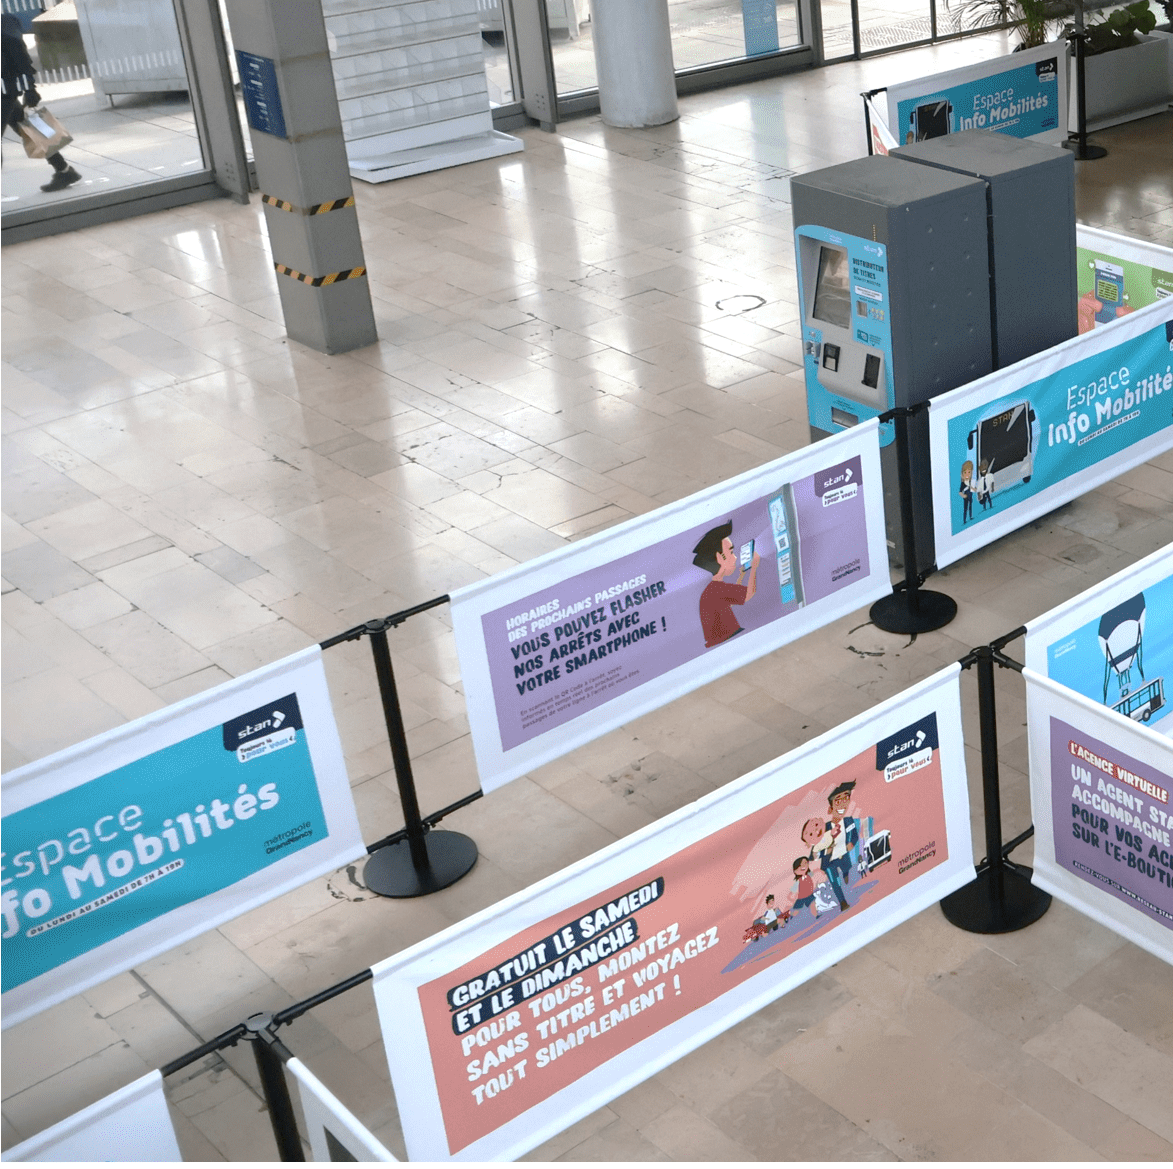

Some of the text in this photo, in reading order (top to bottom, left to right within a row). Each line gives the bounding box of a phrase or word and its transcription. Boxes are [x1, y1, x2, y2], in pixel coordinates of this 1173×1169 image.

[960, 92, 1048, 131] Info Mobilités
[973, 87, 1014, 111] Espace
[1066, 366, 1131, 411] Espace
[1048, 410, 1090, 447] Info
[823, 474, 844, 488] stan
[506, 598, 560, 631] HORAIRES
[507, 574, 647, 643] DES PROCHAINS PASSAGES
[511, 580, 666, 660] VOUS POUVEZ FLASHER
[514, 611, 640, 679] NOS ARRÊTS AVEC
[516, 616, 667, 696] VOTRE SMARTPHONE !
[238, 719, 271, 739] stan
[887, 738, 915, 759] stan
[891, 767, 909, 779] pour
[1070, 742, 1168, 802] L'AGENCE VIRTUELLE
[1071, 763, 1092, 787] UN
[1097, 778, 1144, 814] AGENT
[61, 782, 280, 900] Mobilités
[264, 821, 311, 847] métropole
[1071, 784, 1170, 848] ACCOMPAGNE
[1071, 803, 1109, 835] POUR
[1115, 824, 1143, 852] VOS
[1072, 822, 1100, 849] SUR
[898, 841, 935, 867] métropole
[899, 849, 936, 874] GrandNancy
[30, 926, 43, 936] DU
[47, 912, 76, 928] LUNDI
[79, 905, 92, 915] AU
[94, 886, 129, 908] SAMEDI
[130, 879, 142, 890] DE
[144, 873, 155, 883] 7H
[452, 881, 658, 1007] GRATUIT LE SAMEDI
[456, 921, 636, 1033] ET LE DIMANCHE
[461, 922, 681, 1057] POUR TOUS, MONTEZ
[466, 926, 719, 1082] SANS TITRE ET VOYAGEZ
[471, 974, 682, 1105] TOUT SIMPLEMENT !
